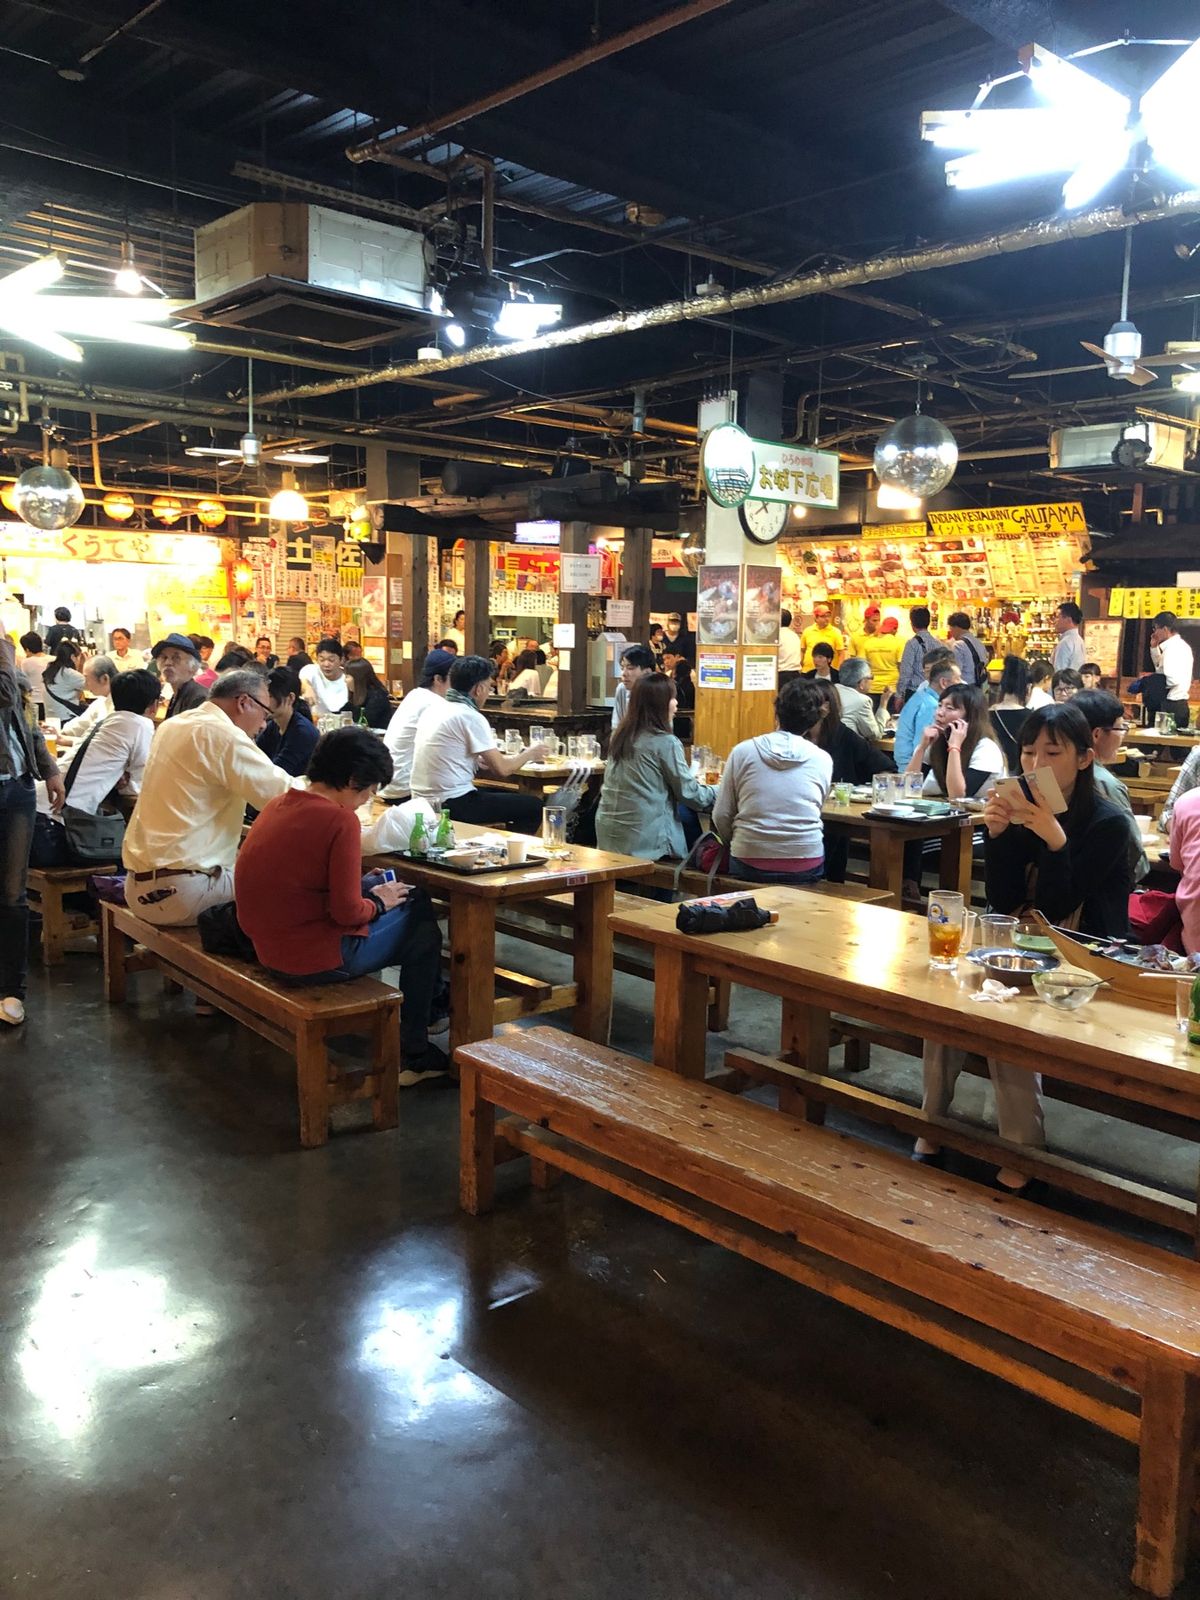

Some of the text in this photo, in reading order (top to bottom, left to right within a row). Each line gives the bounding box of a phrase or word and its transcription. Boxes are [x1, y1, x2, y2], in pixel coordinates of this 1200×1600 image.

[759, 464, 834, 500] お城下広場
[930, 506, 1083, 524] INDIAN RESTAURANT GAUTAMA
